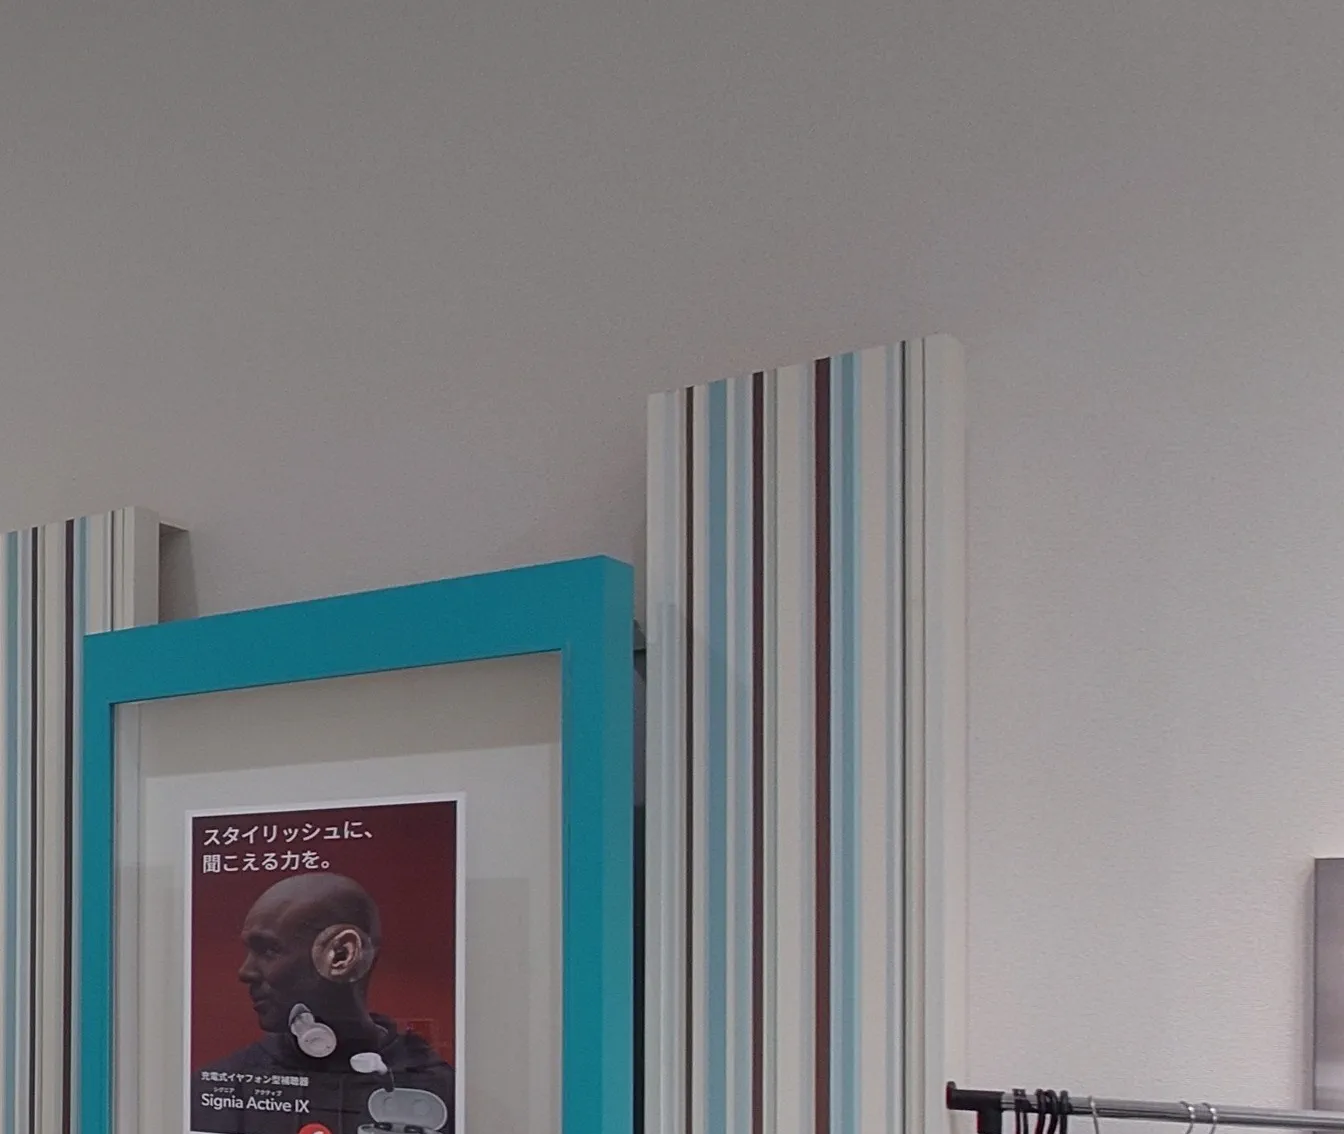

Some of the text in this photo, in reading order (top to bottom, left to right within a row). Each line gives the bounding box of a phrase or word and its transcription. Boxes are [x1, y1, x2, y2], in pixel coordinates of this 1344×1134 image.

[203, 821, 373, 846] スタイリッシュに、
[202, 850, 331, 873] 聞こえる力を。
[201, 1071, 310, 1087] 充電式イヤフォン型補聴器
[201, 1093, 310, 1114] Signia Active IX
